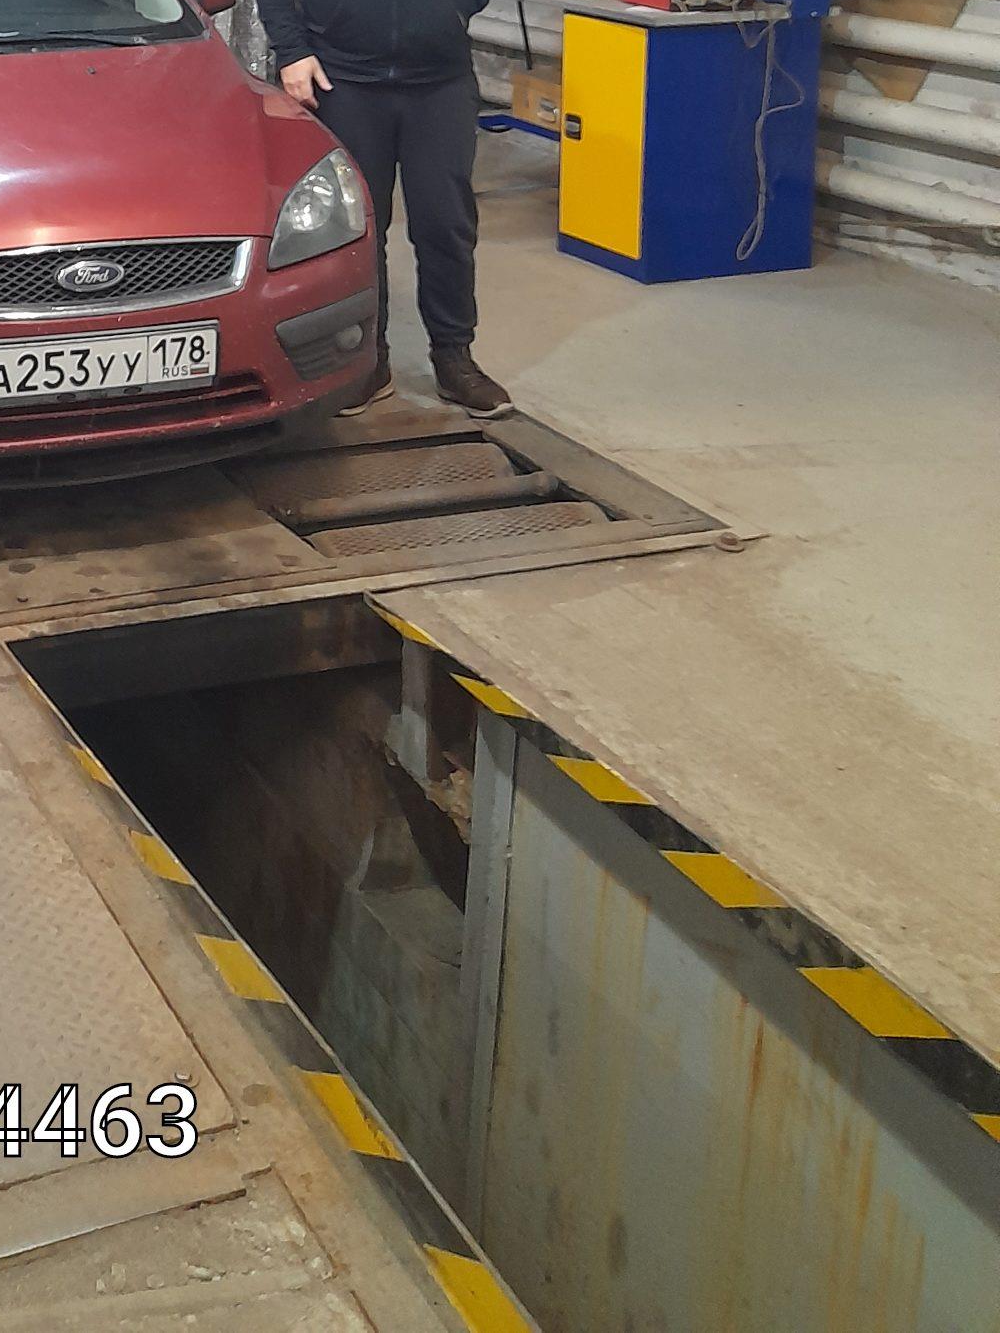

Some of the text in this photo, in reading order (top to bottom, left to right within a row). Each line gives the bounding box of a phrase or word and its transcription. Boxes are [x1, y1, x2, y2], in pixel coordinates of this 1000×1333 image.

[74, 266, 110, 285] Ford
[152, 335, 205, 368] 178
[161, 366, 189, 379] RUS
